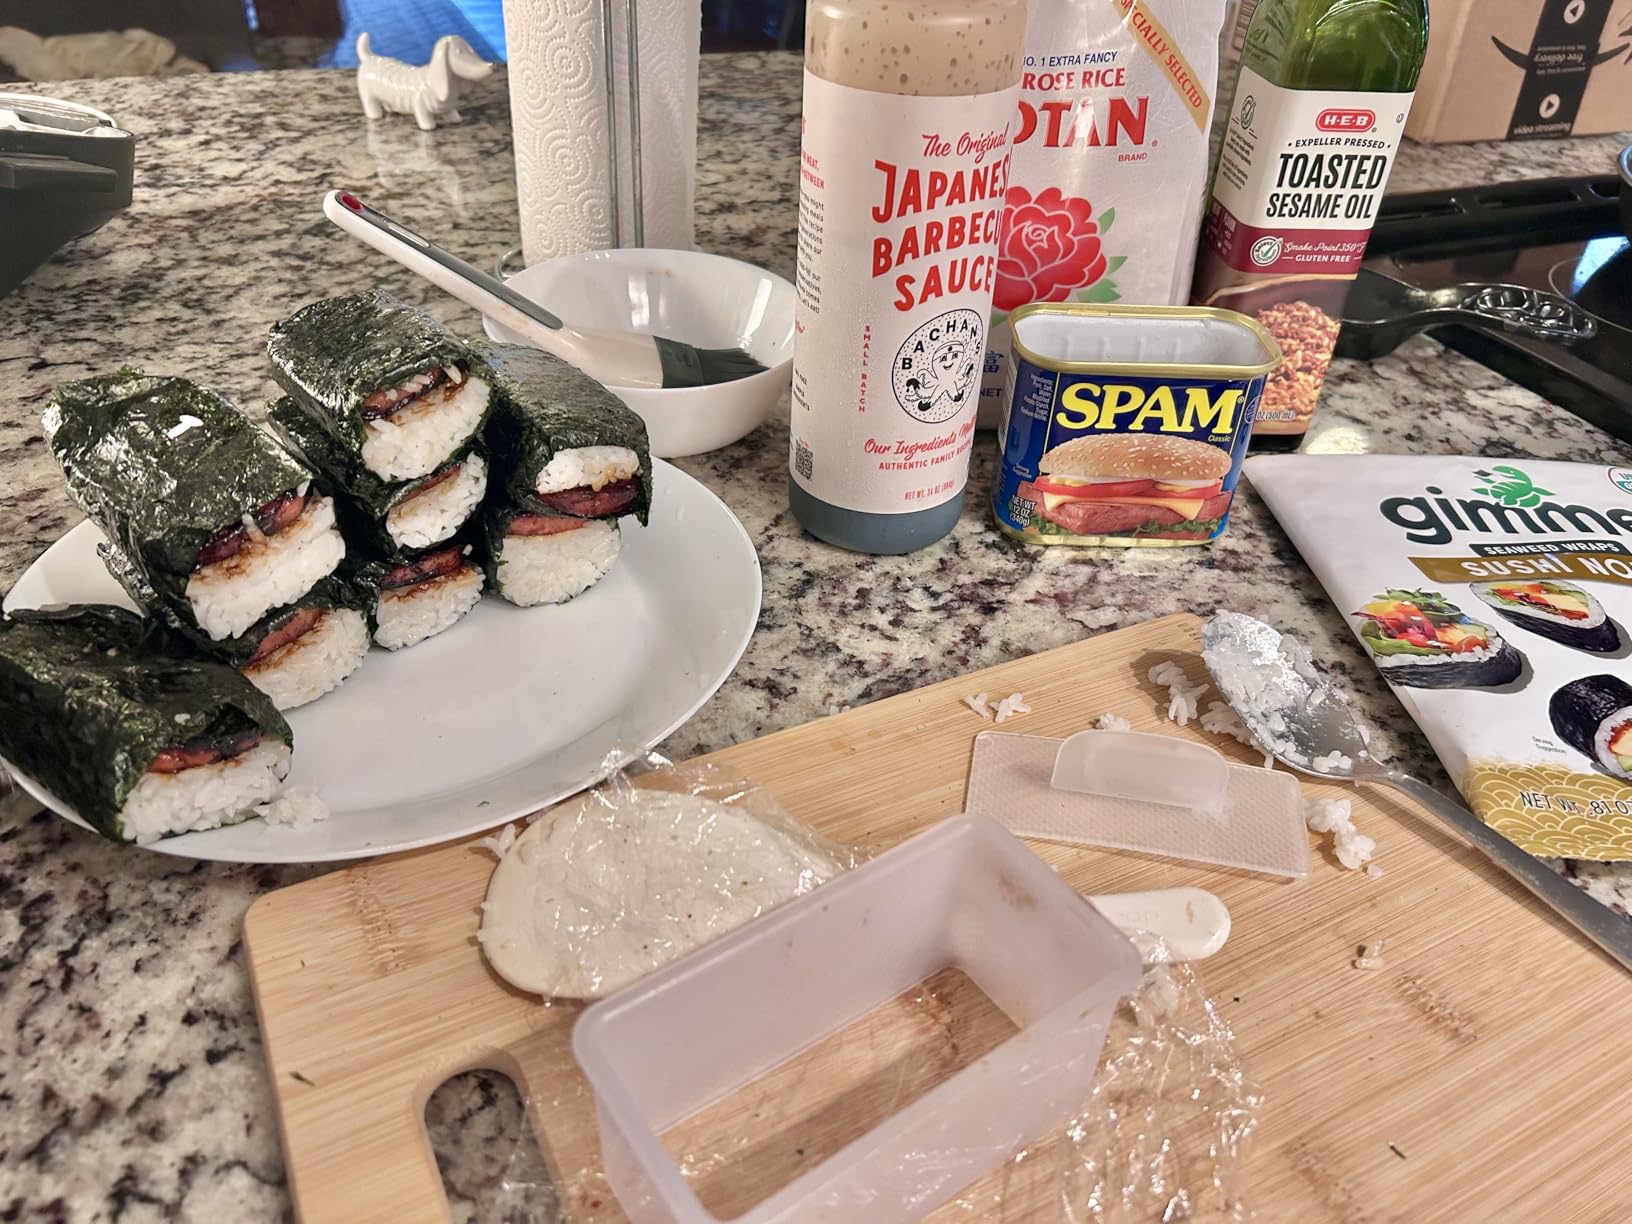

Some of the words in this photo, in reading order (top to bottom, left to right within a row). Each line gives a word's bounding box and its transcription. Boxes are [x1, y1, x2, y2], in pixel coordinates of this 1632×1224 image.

[1041, 57, 1046, 67] 1
[1050, 56, 1081, 67] EXTRA
[1084, 51, 1118, 64] FANCY
[1121, 0, 1169, 56] SPCIALLY
[1165, 54, 1201, 109] SELECTED
[1022, 72, 1074, 90] ROSE
[1081, 68, 1126, 89] RICE
[922, 134, 951, 157] The
[956, 121, 1010, 164] Original
[1295, 138, 1342, 148] EXPELLER
[1344, 138, 1385, 149] PRESSED
[1118, 152, 1148, 162] BRAND
[1276, 153, 1388, 190] TOASTED
[1266, 193, 1343, 219] SESAME
[1344, 194, 1374, 219] OIL
[1284, 241, 1313, 253] Smoke
[1314, 241, 1339, 252] Point
[1295, 254, 1328, 262] GLUTEN
[1330, 254, 1351, 263] FREE
[894, 255, 995, 312] SAUCE
[863, 325, 871, 366] SMALL
[858, 373, 867, 413] BATCH
[1055, 382, 1243, 434] SPAM
[864, 438, 891, 455] Our
[893, 431, 957, 461] Ingredients
[1208, 434, 1231, 442] Classic
[879, 460, 928, 471] AUTHENTIC
[930, 452, 955, 466] FAMILY
[1012, 495, 1023, 506] NET
[1024, 501, 1037, 510] WT
[1013, 505, 1021, 514] 12
[1020, 508, 1031, 518] OZ
[1009, 513, 1031, 528] (340g)
[1485, 544, 1557, 555] SEAWEED
[1563, 542, 1620, 553] WRAPS
[1460, 556, 1574, 577] SUSHI
[1576, 557, 1632, 579] NO
[1519, 791, 1552, 810] NET
